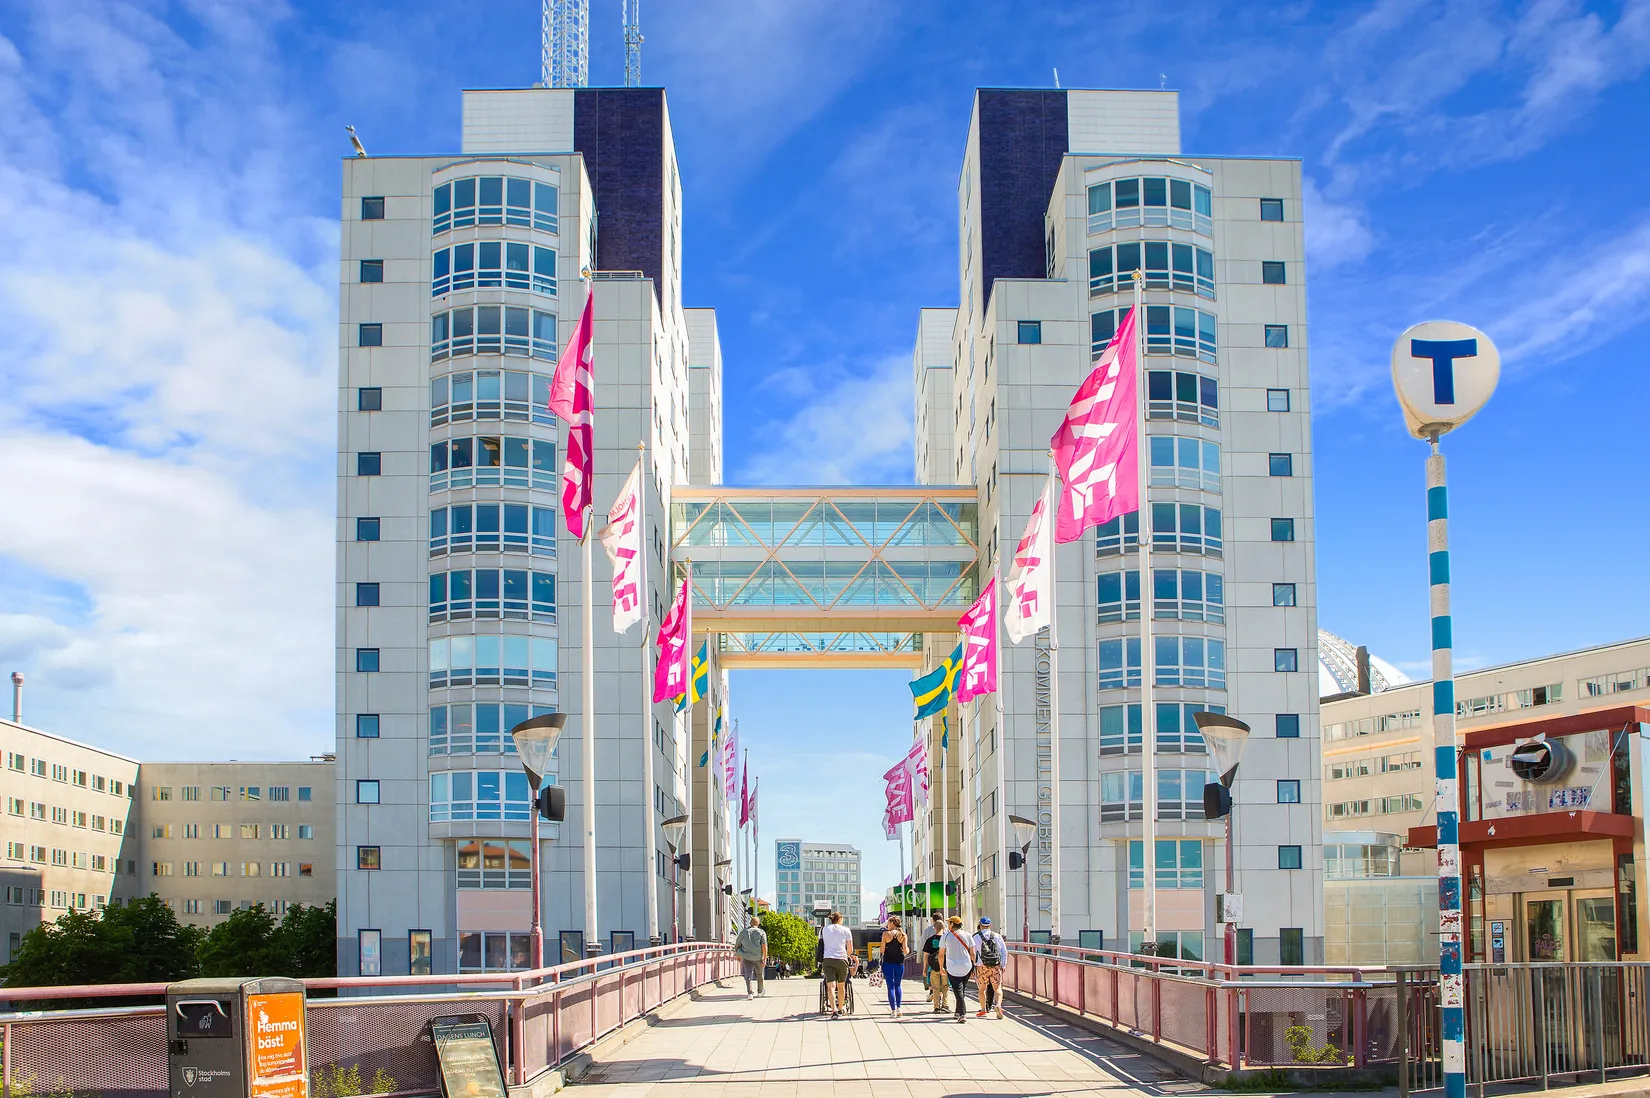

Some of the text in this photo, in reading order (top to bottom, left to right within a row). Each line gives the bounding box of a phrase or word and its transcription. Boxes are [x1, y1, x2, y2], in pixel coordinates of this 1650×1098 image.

[1411, 338, 1477, 404] T
[1038, 785, 1053, 865] GLOBEN
[1039, 873, 1053, 913] CITY
[258, 1020, 297, 1033] Hemma
[258, 1034, 284, 1049] bäst!
